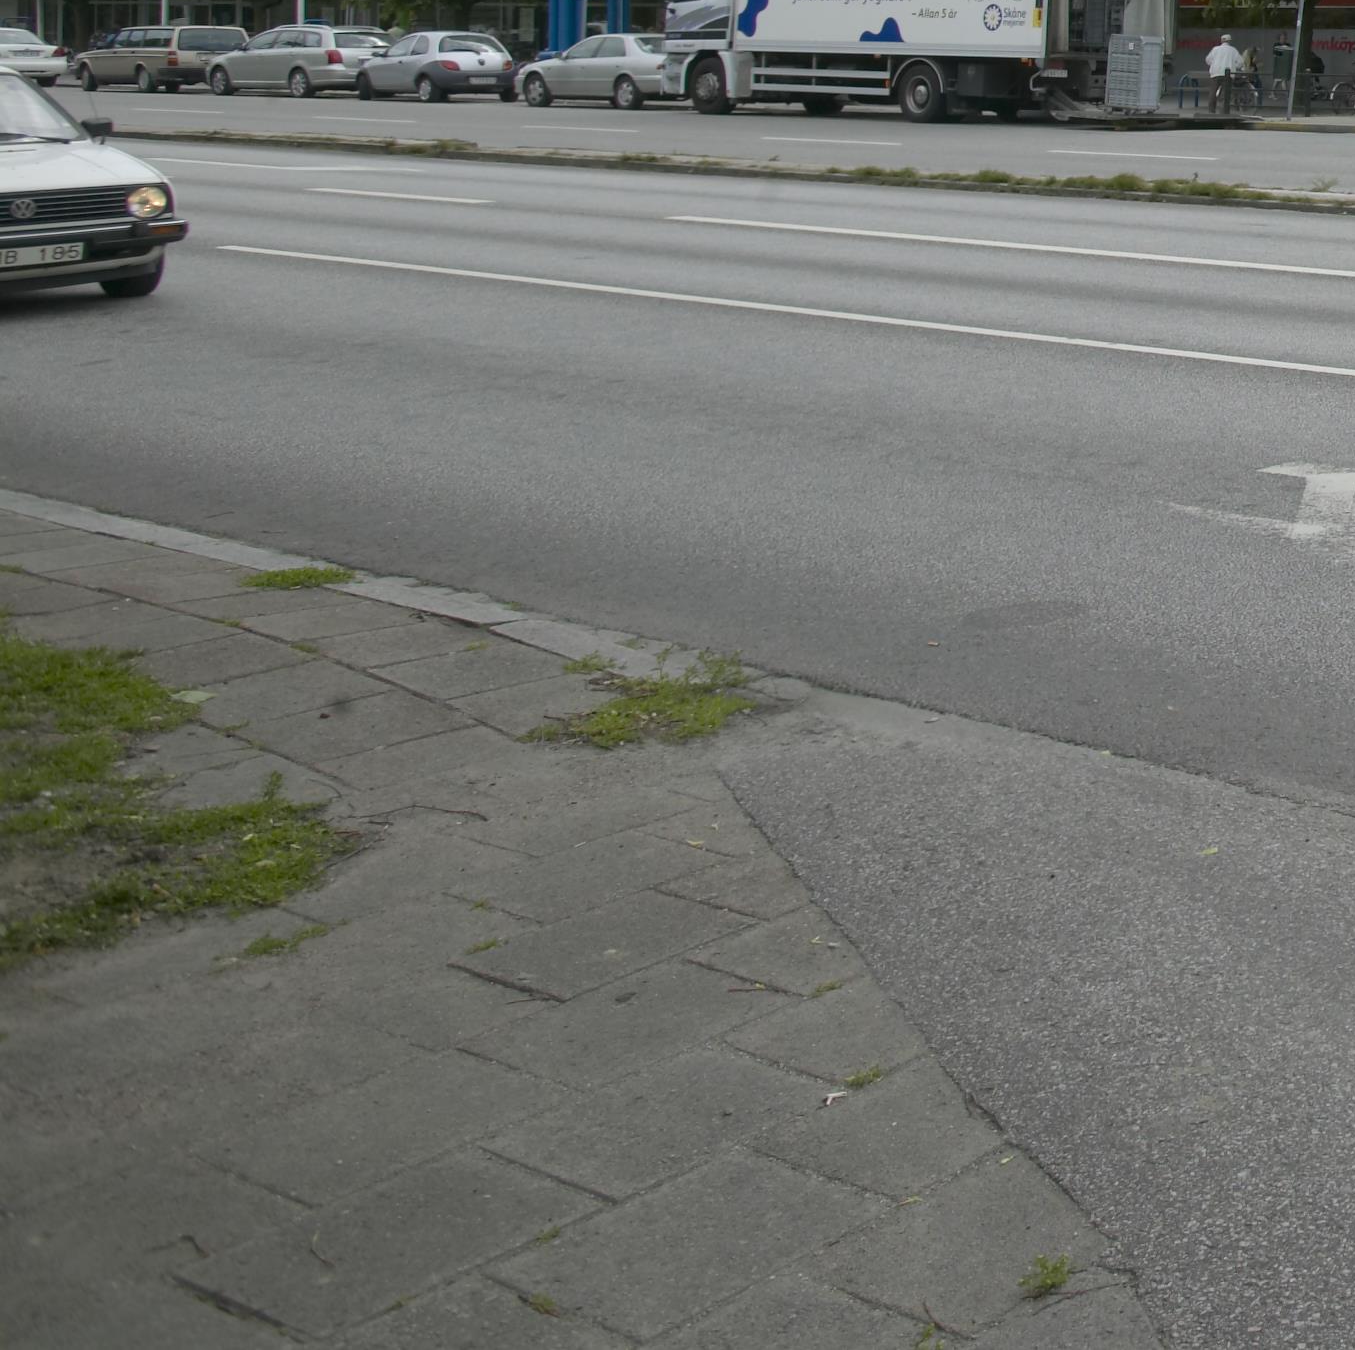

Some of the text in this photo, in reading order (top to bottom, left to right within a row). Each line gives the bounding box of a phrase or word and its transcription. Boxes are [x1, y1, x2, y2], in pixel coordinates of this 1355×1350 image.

[918, 7, 940, 19] Allan
[941, 8, 947, 19] 5
[1003, 6, 1027, 19] Skåne
[39, 244, 81, 263] 185
